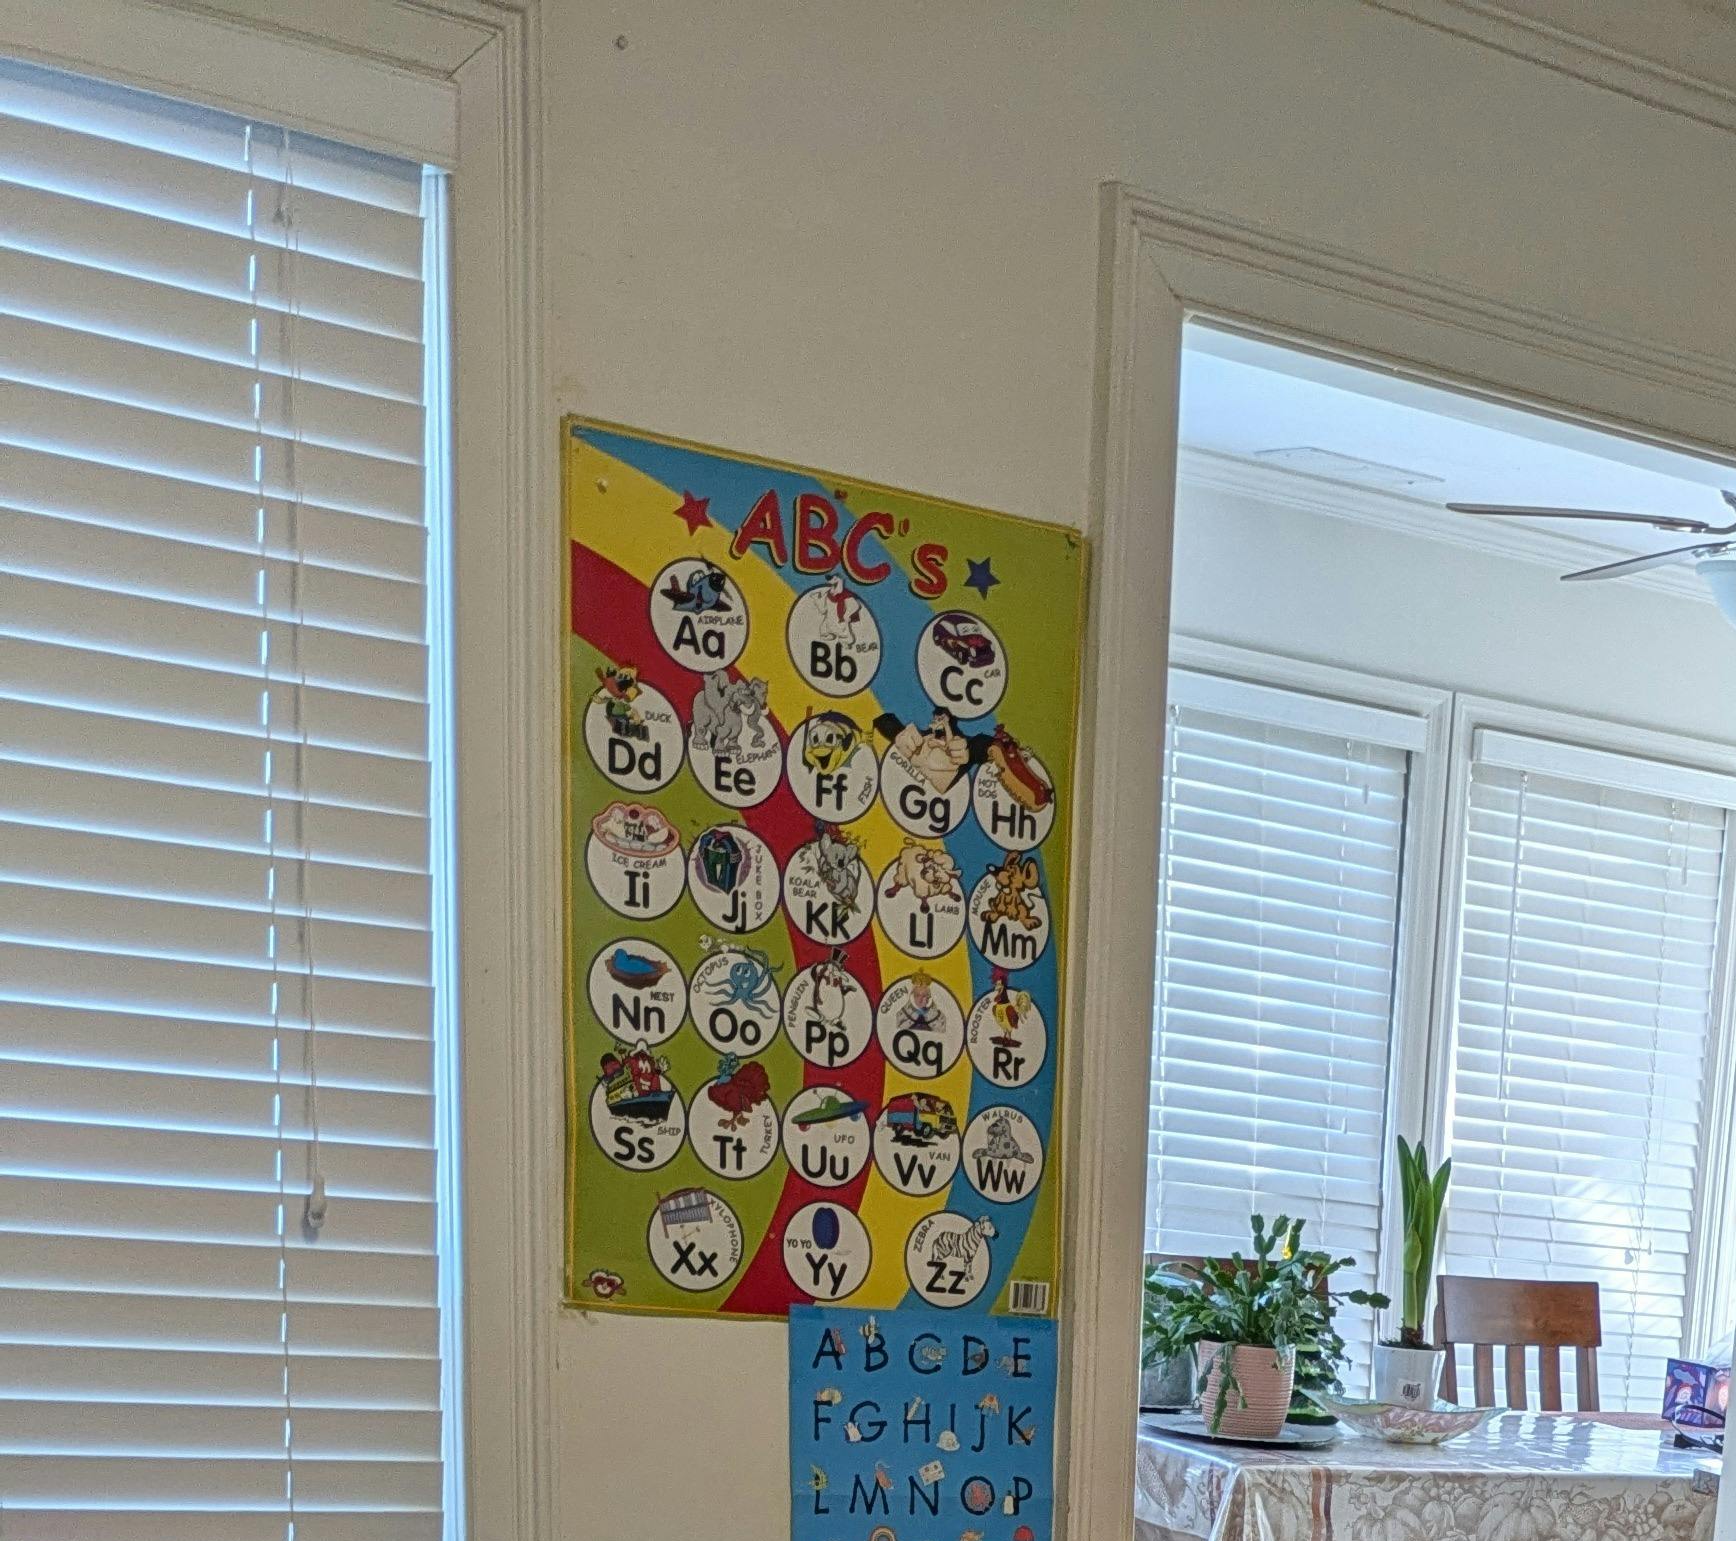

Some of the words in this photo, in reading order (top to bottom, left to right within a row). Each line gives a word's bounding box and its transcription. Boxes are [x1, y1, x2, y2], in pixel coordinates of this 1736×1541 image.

[730, 489, 948, 598] ABC's
[673, 615, 725, 659] Aa
[697, 615, 744, 626] AIRPLANE
[810, 640, 857, 683] Bb
[855, 642, 879, 653] BEAR
[940, 665, 984, 706] Cc
[984, 668, 1001, 679] CAR
[645, 711, 672, 724] DUCK
[608, 737, 662, 781] Dd
[736, 743, 780, 765] ELEPHANT
[889, 752, 928, 786] GORILLA
[714, 756, 756, 796] Ee
[816, 773, 848, 811] Ff
[857, 777, 874, 805] FISH
[978, 779, 997, 788] HOT
[900, 785, 950, 833] Gg
[991, 801, 1036, 841] Hh
[611, 853, 628, 869] ICE
[633, 856, 667, 869] CREAM
[624, 870, 649, 908] Ii
[789, 876, 821, 888] KOALA
[792, 887, 817, 899] BEAR
[970, 879, 991, 916] MOUSE
[722, 889, 746, 932] Jj
[806, 900, 851, 940] Kk
[934, 903, 960, 915] LAMB
[981, 921, 1037, 960] Mm
[693, 957, 730, 994] OCTOPUS
[612, 993, 665, 1034] Nn
[787, 979, 810, 1028] PENGUIN
[880, 987, 909, 1015] QUEEN
[709, 1008, 761, 1046] Oo
[970, 997, 993, 1044] ROOSTER
[806, 1020, 849, 1067] Pp
[892, 1029, 943, 1076] Qq
[992, 1047, 1025, 1081] Rr
[614, 1126, 655, 1163] Ss
[713, 1135, 747, 1171] Tt
[759, 1114, 773, 1155] TURKEY
[834, 1134, 855, 1144] UFO
[802, 1143, 849, 1180] Uu
[894, 1152, 936, 1188] Vv
[929, 1152, 950, 1161] VAN
[977, 1158, 1025, 1195] Ww
[709, 1198, 739, 1264] XYLOPHONE
[787, 1238, 798, 1249] YO
[800, 1239, 812, 1249] YO
[913, 1219, 935, 1253] ZEBRA
[670, 1240, 718, 1277] Xx
[805, 1252, 847, 1296] Yy
[925, 1261, 966, 1295] Zz
[812, 1327, 843, 1371] A
[864, 1331, 889, 1372] B
[908, 1333, 943, 1375] C
[962, 1334, 990, 1376] D
[1011, 1337, 1032, 1378] E
[813, 1399, 832, 1442] F
[849, 1400, 887, 1443] G
[903, 1401, 931, 1444] H
[971, 1403, 988, 1452] J
[1007, 1405, 1032, 1446] K
[849, 1474, 890, 1516] M
[908, 1475, 939, 1516] N
[960, 1476, 996, 1516] O
[1012, 1476, 1033, 1516] P
